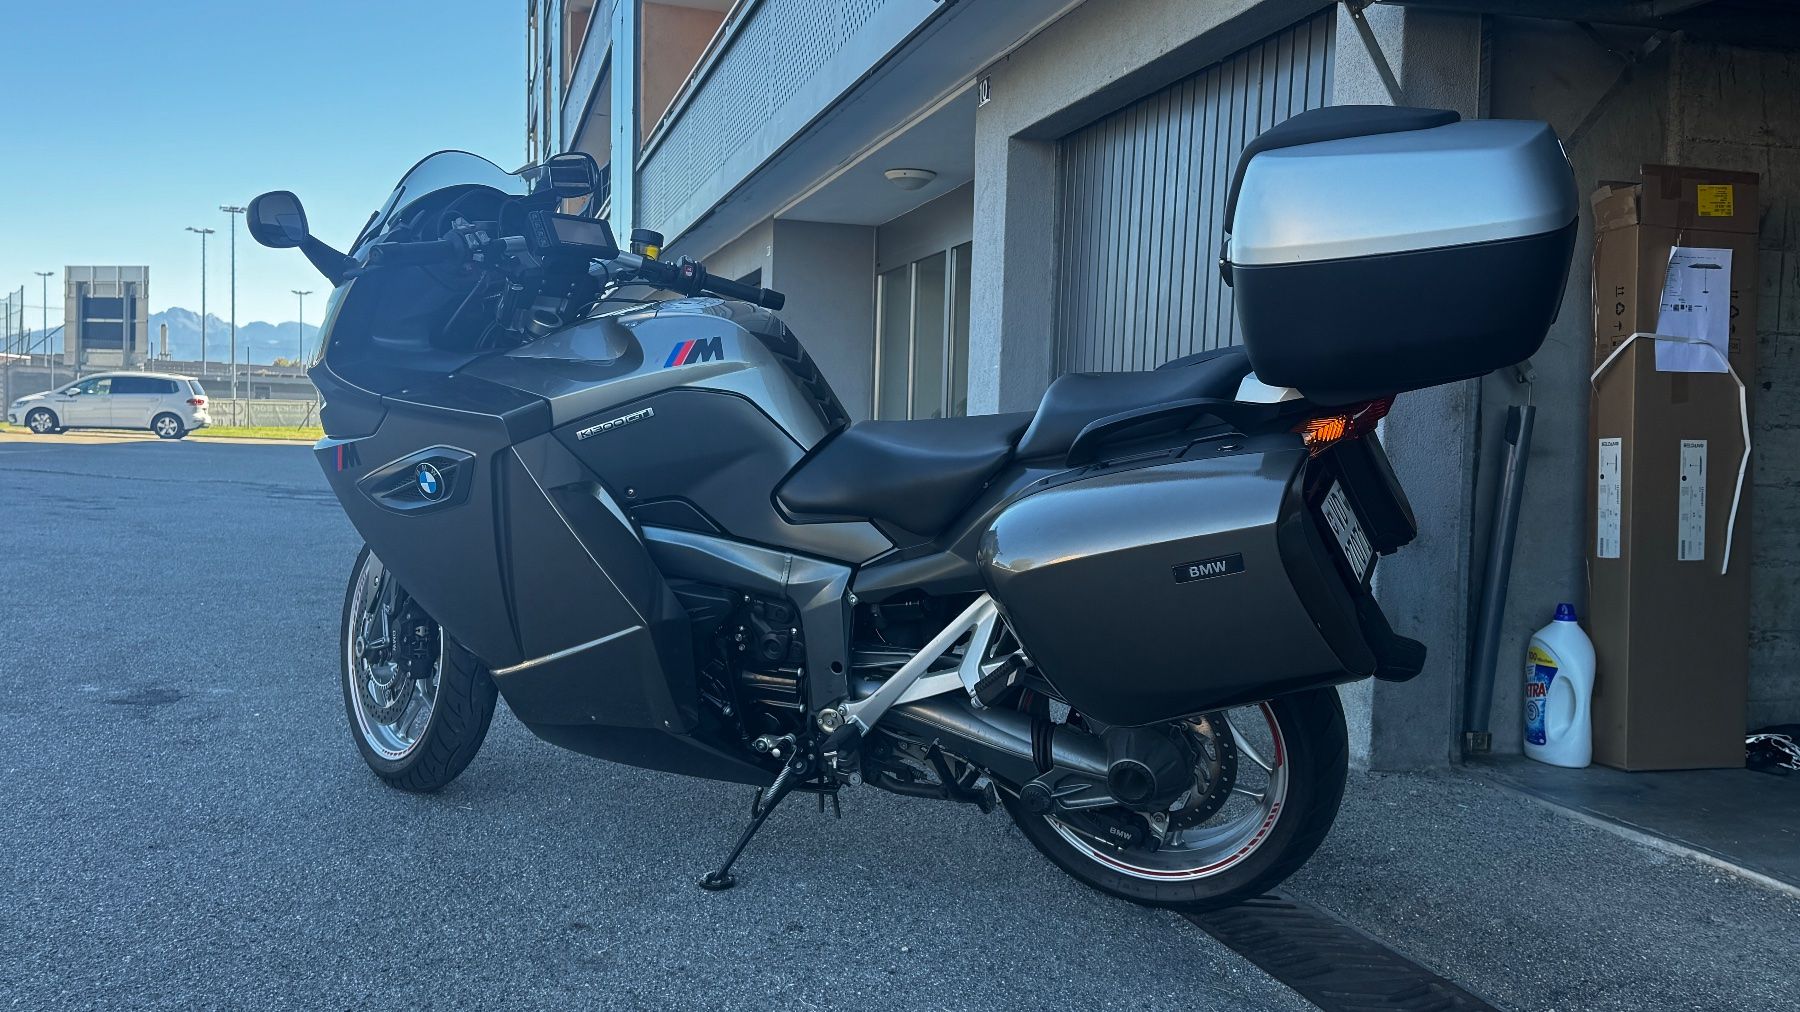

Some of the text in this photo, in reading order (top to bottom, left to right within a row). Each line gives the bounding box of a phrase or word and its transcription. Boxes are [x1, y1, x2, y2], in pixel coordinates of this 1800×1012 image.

[979, 79, 988, 104] 10
[1326, 489, 1349, 532] VD
[1343, 520, 1372, 580] 27071
[1188, 560, 1226, 578] BMW
[1109, 826, 1132, 840] BMW
